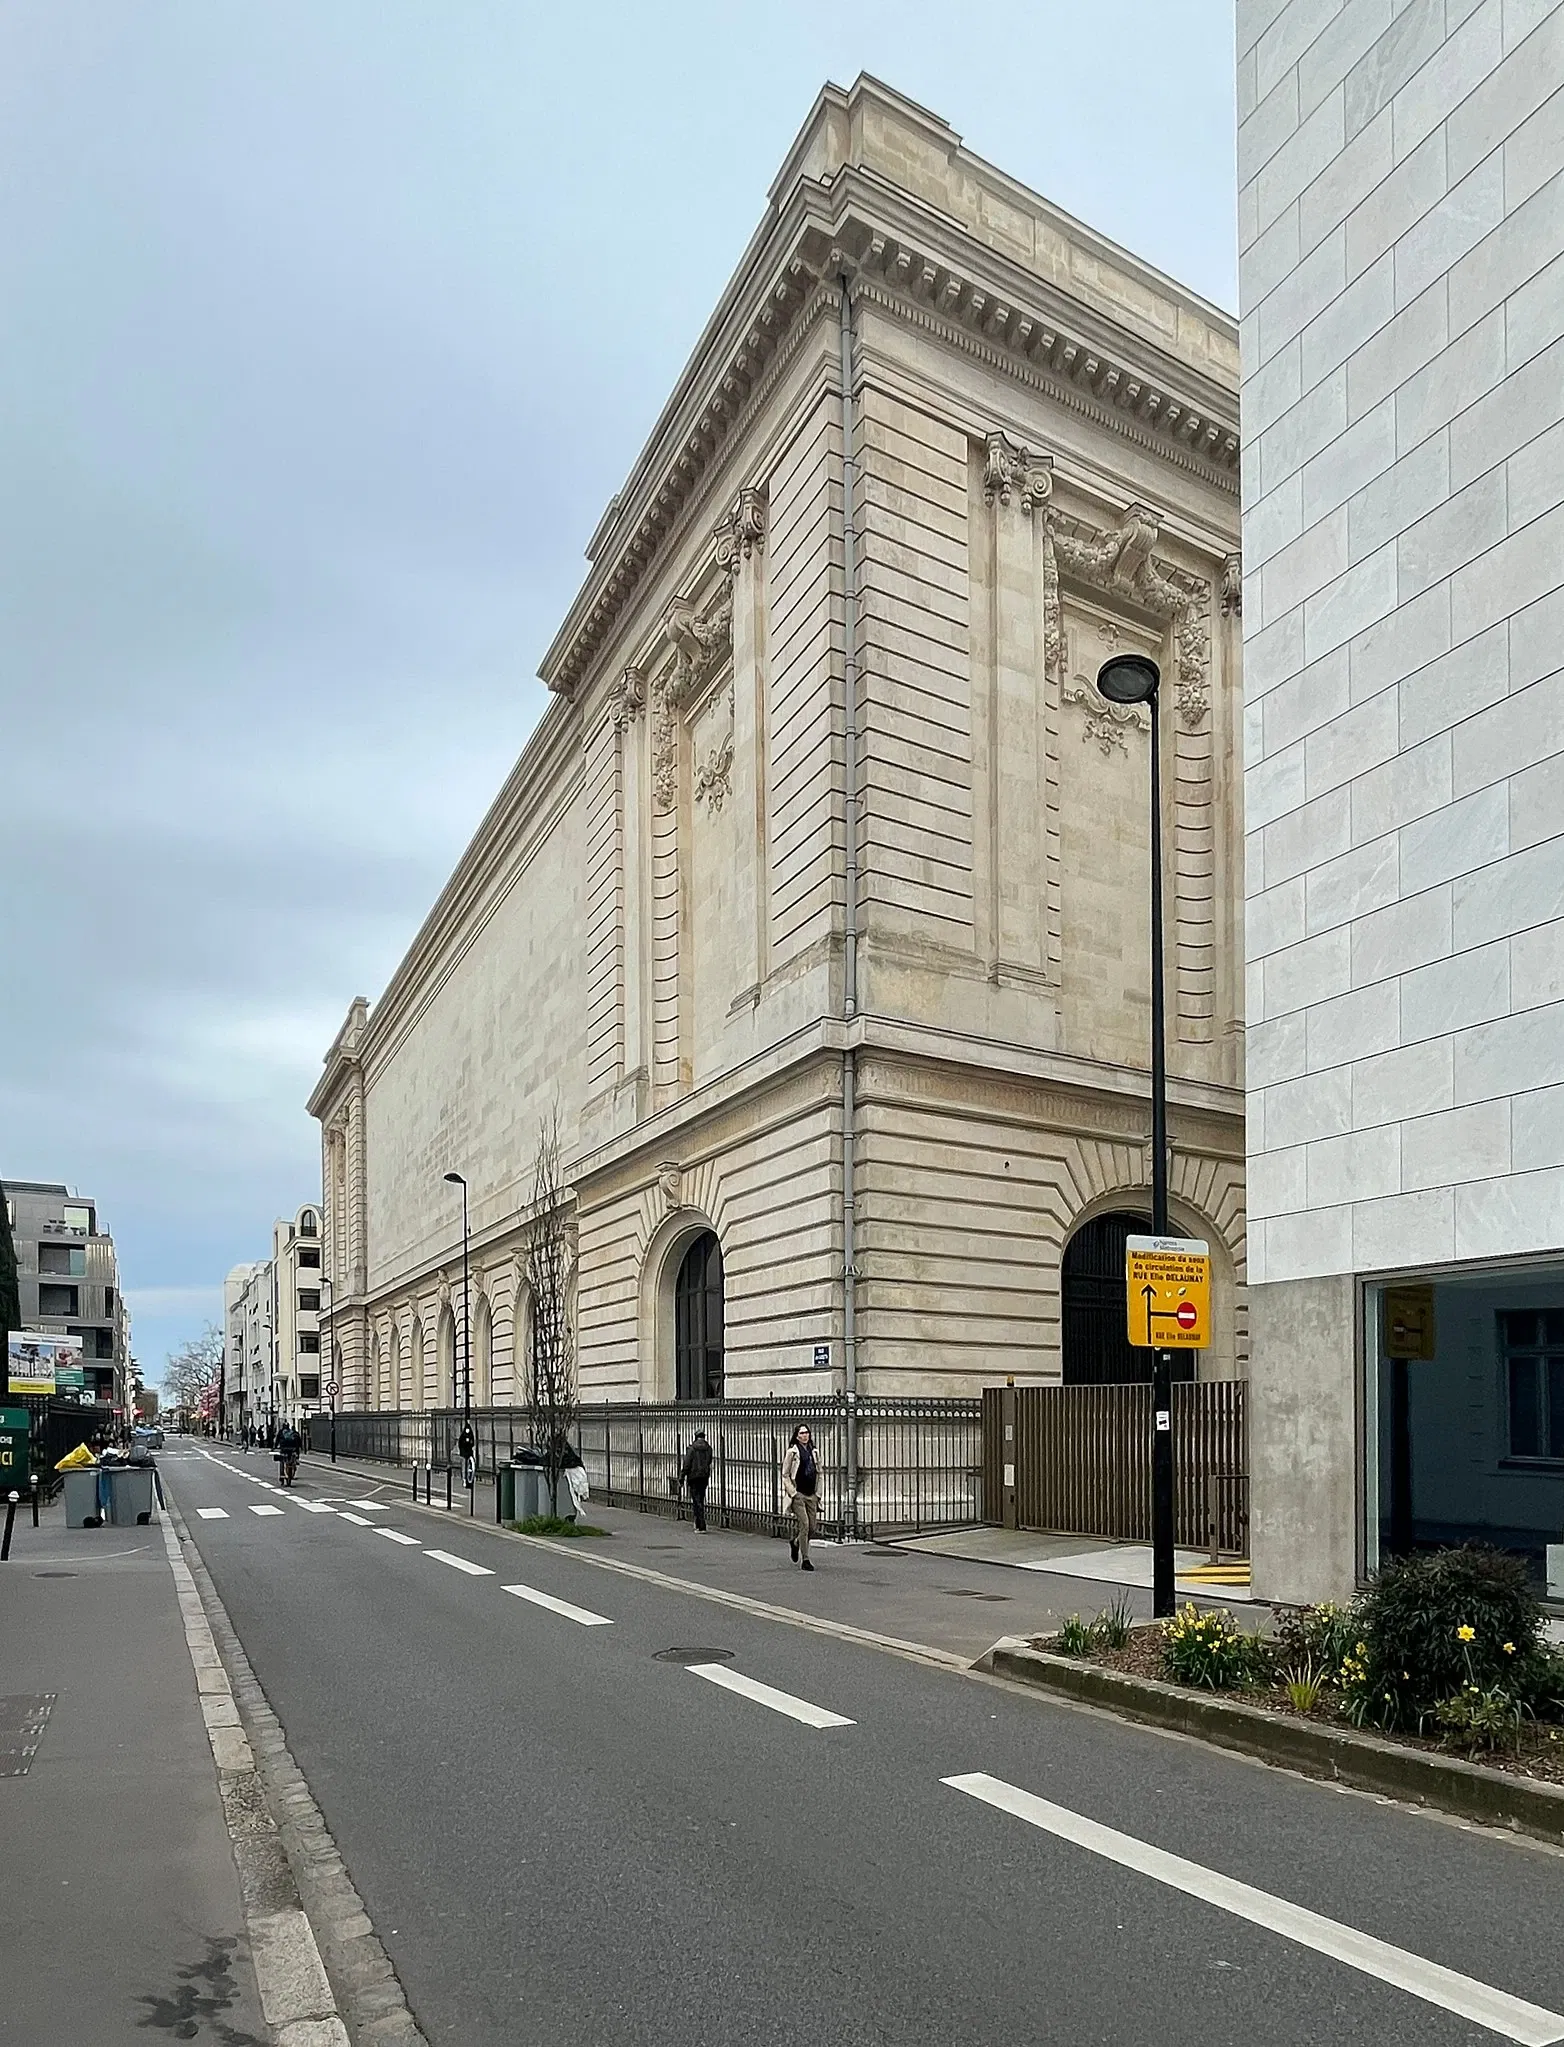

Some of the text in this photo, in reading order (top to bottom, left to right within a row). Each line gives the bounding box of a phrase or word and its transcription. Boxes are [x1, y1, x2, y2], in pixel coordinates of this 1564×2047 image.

[1132, 1252, 1176, 1262] Modification
[1134, 1262, 1142, 1270] de
[1145, 1263, 1184, 1272] circulation
[1186, 1265, 1194, 1273] de
[1133, 1272, 1203, 1283] RUE Elie DELAUNAY
